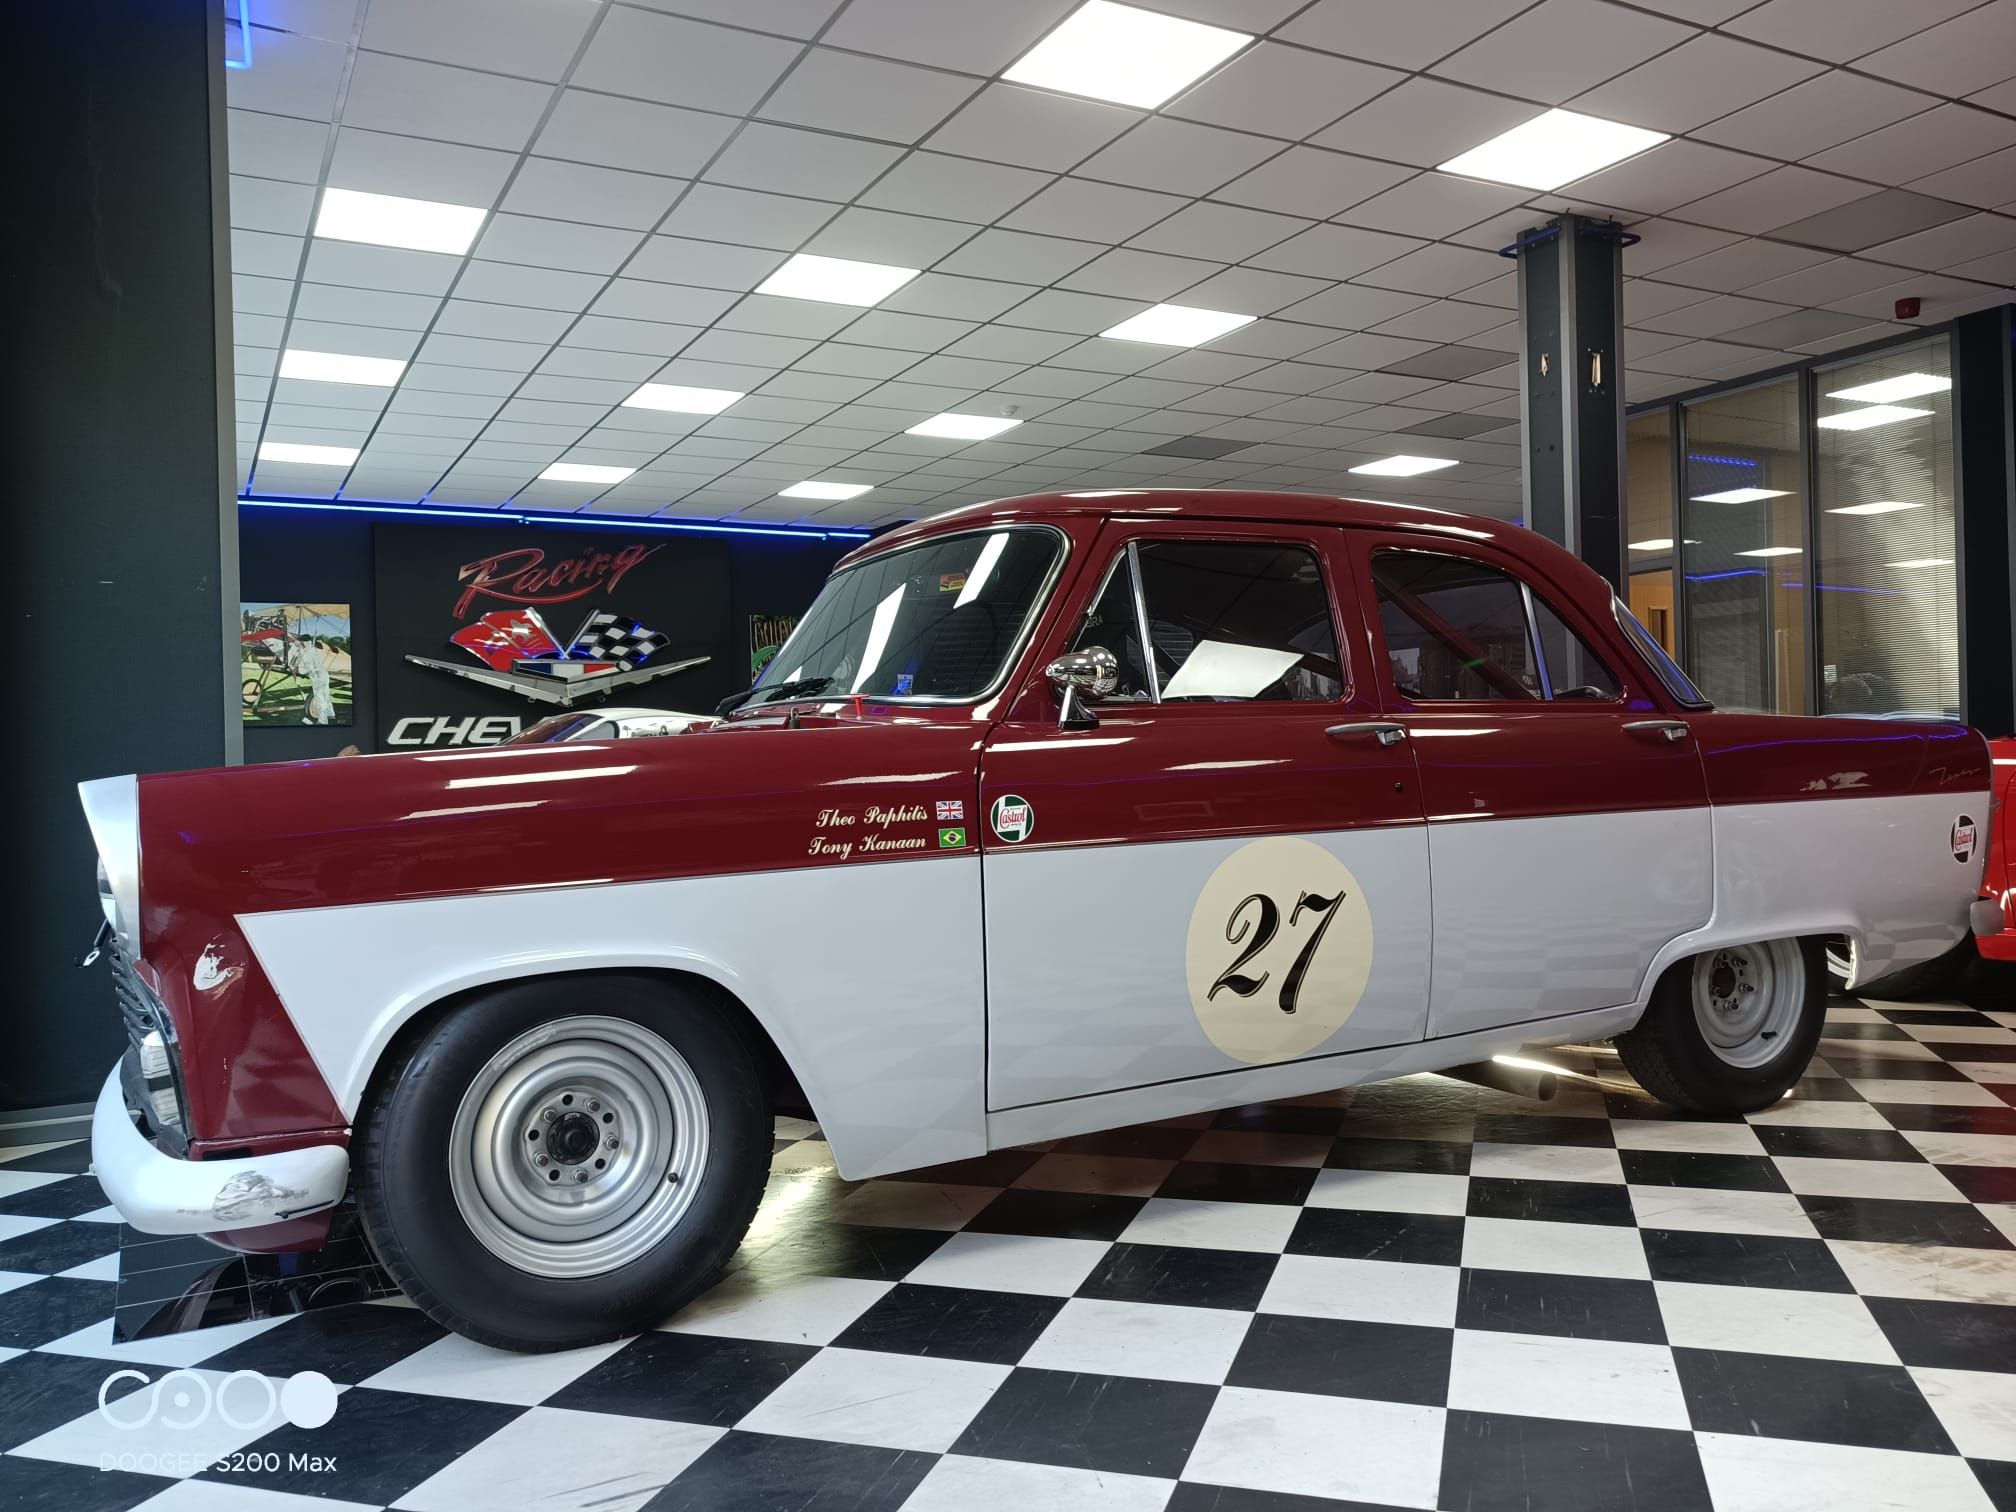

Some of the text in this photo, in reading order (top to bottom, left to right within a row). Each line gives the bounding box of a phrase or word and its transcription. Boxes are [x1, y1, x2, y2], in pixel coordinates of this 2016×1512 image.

[453, 543, 667, 619] Racing
[815, 808, 856, 828] Theo
[1000, 806, 1026, 829] Castrol
[808, 833, 927, 861] Tony Kanaan
[1207, 890, 1346, 1014] 27
